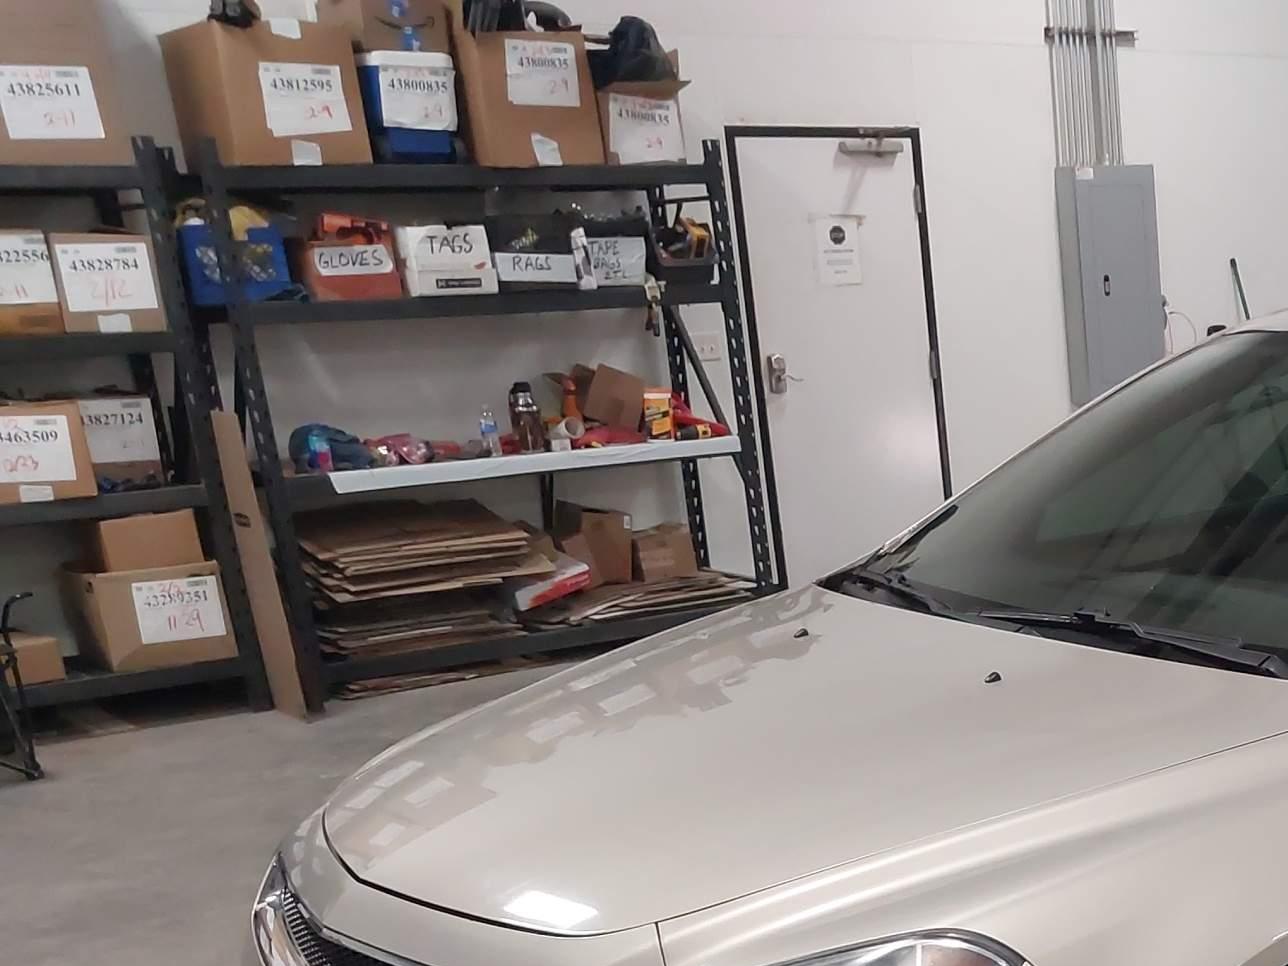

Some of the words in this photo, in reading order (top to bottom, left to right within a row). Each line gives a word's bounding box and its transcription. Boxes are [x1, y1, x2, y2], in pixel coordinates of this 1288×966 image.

[518, 55, 569, 70] 43800835
[7, 82, 81, 97] 43825611
[270, 77, 333, 93] 43812595
[388, 77, 448, 92] 43800835
[426, 233, 473, 255] TAGS
[588, 240, 620, 256] TAPE
[68, 258, 139, 272] 43828784
[319, 249, 384, 269] GLOVES
[512, 256, 552, 272] RAGS
